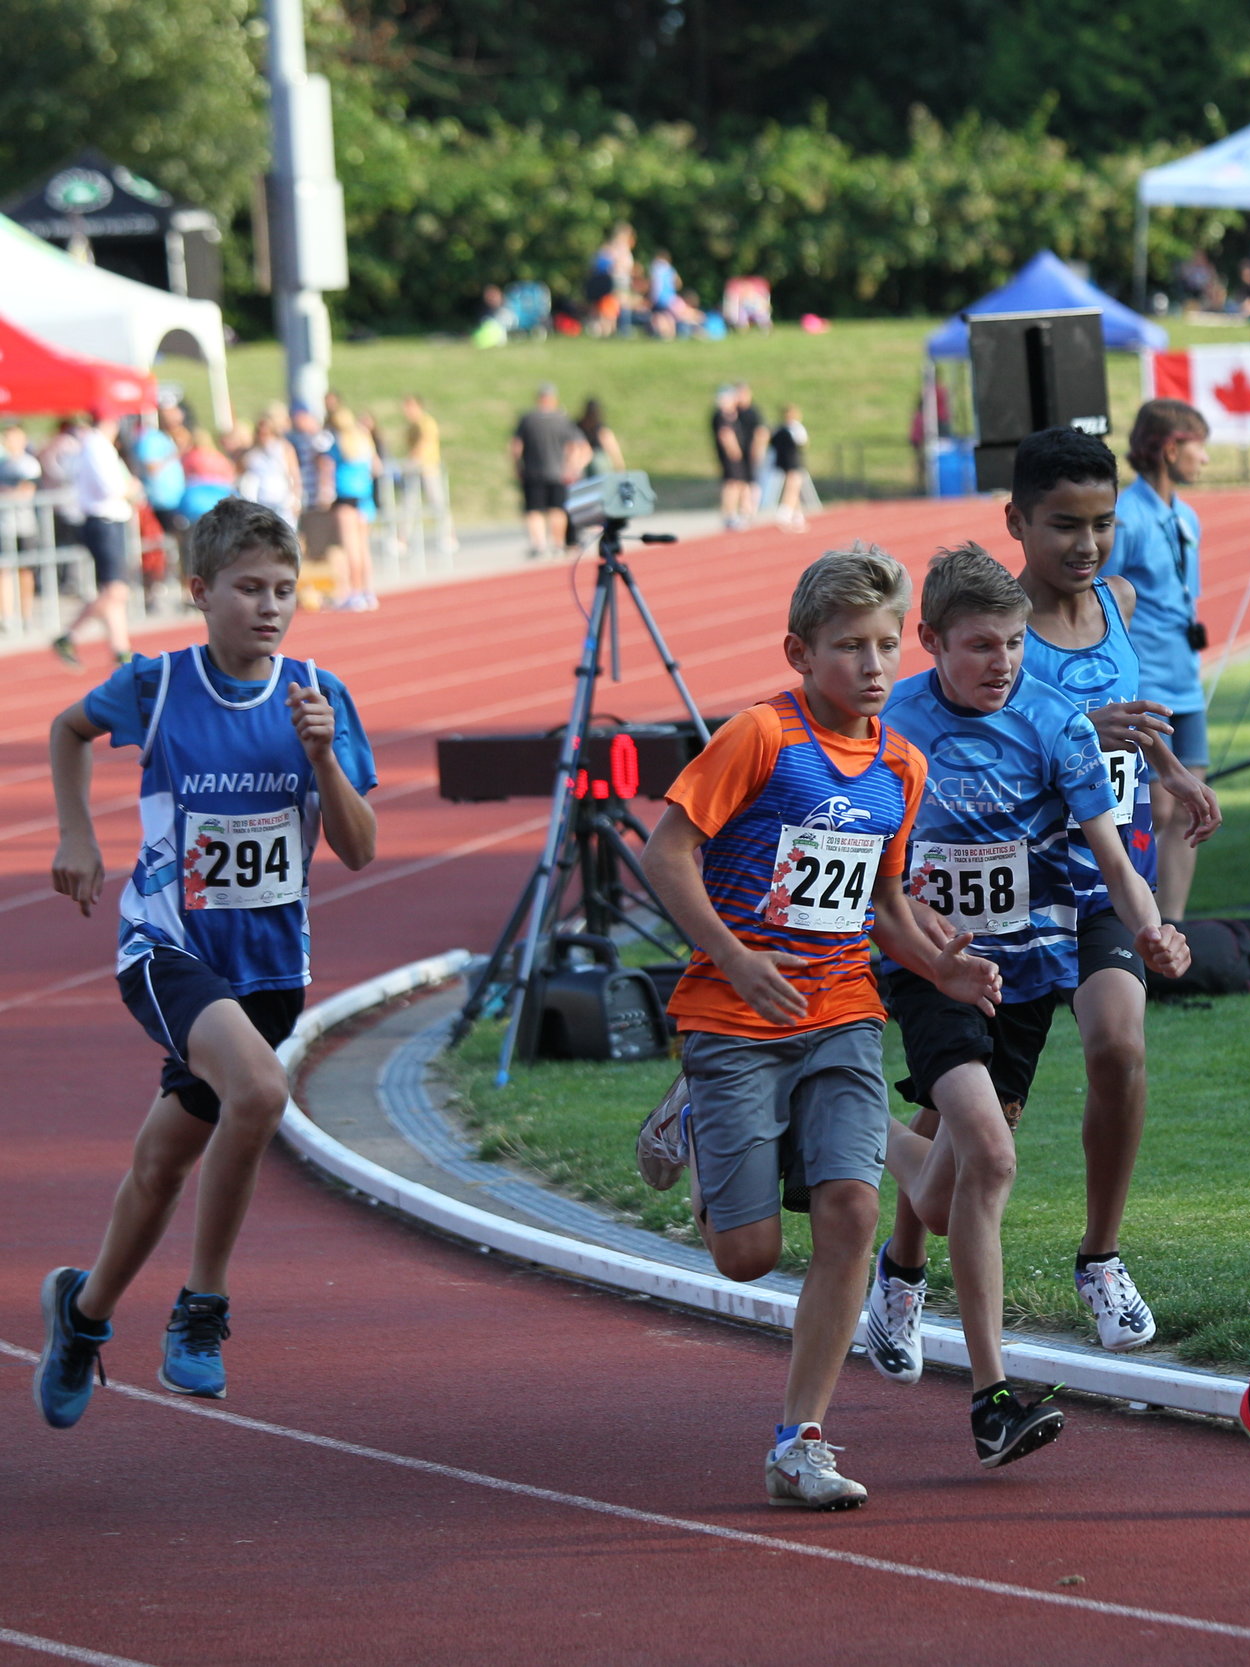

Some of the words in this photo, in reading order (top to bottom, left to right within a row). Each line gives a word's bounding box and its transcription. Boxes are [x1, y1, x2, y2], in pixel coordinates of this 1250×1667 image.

[181, 772, 299, 795] NANAIMO
[232, 820, 248, 828] 2019
[826, 836, 840, 845] 2019
[848, 838, 870, 847] ATHLETICS
[954, 848, 969, 857] 2019
[978, 846, 1008, 856] ATHLETICS
[205, 835, 290, 888] 294
[790, 856, 867, 910] 224
[928, 866, 1015, 917] 358
